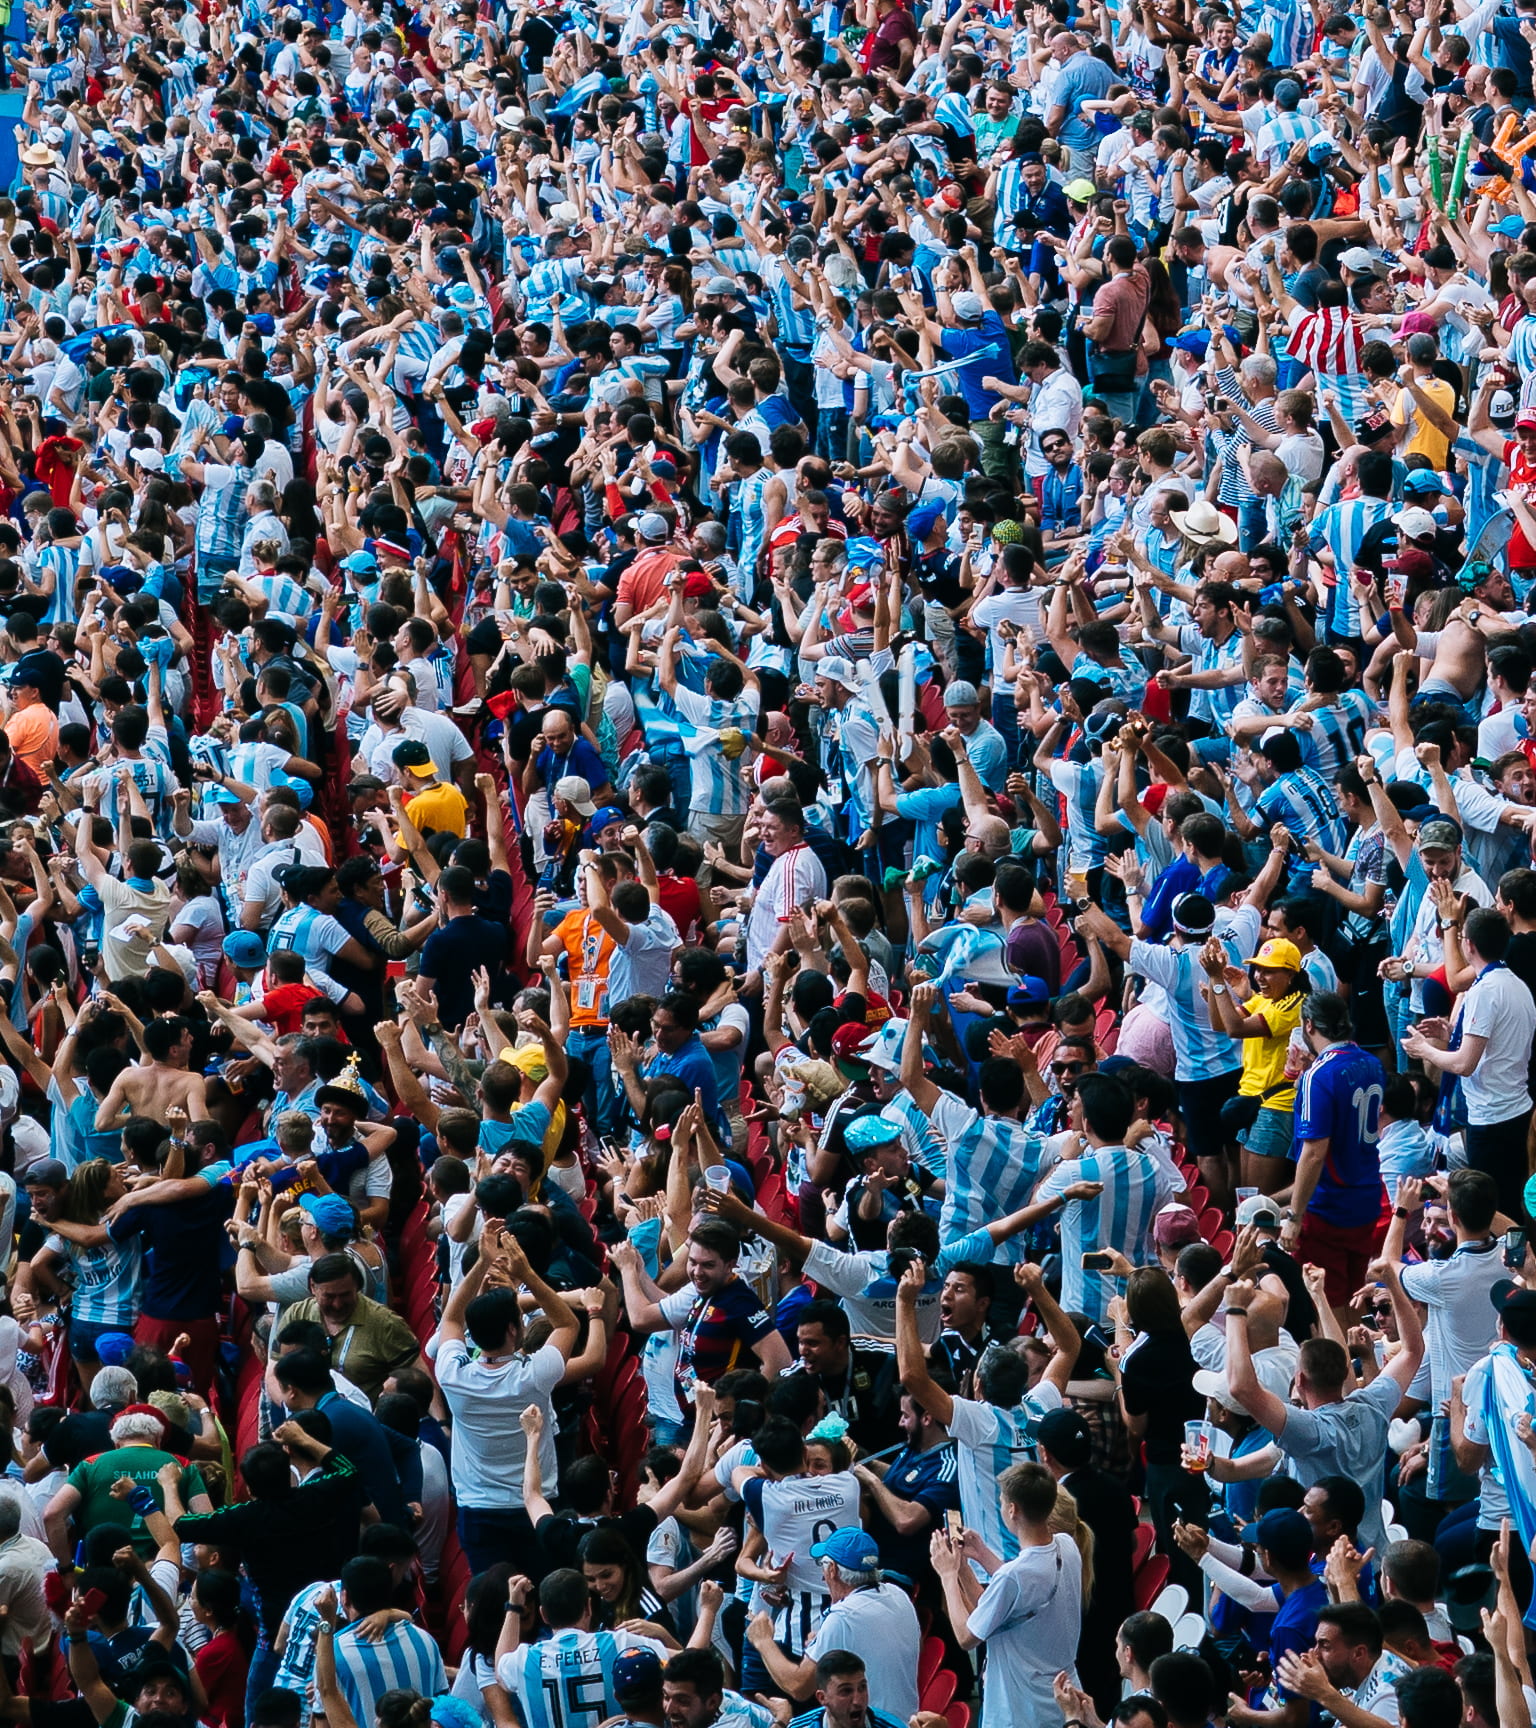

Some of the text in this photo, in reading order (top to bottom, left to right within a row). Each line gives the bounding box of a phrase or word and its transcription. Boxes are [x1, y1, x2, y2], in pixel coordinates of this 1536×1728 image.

[1351, 1083, 1384, 1145] 10
[554, 1646, 604, 1669] PEREZ
[541, 1673, 607, 1728] 15
